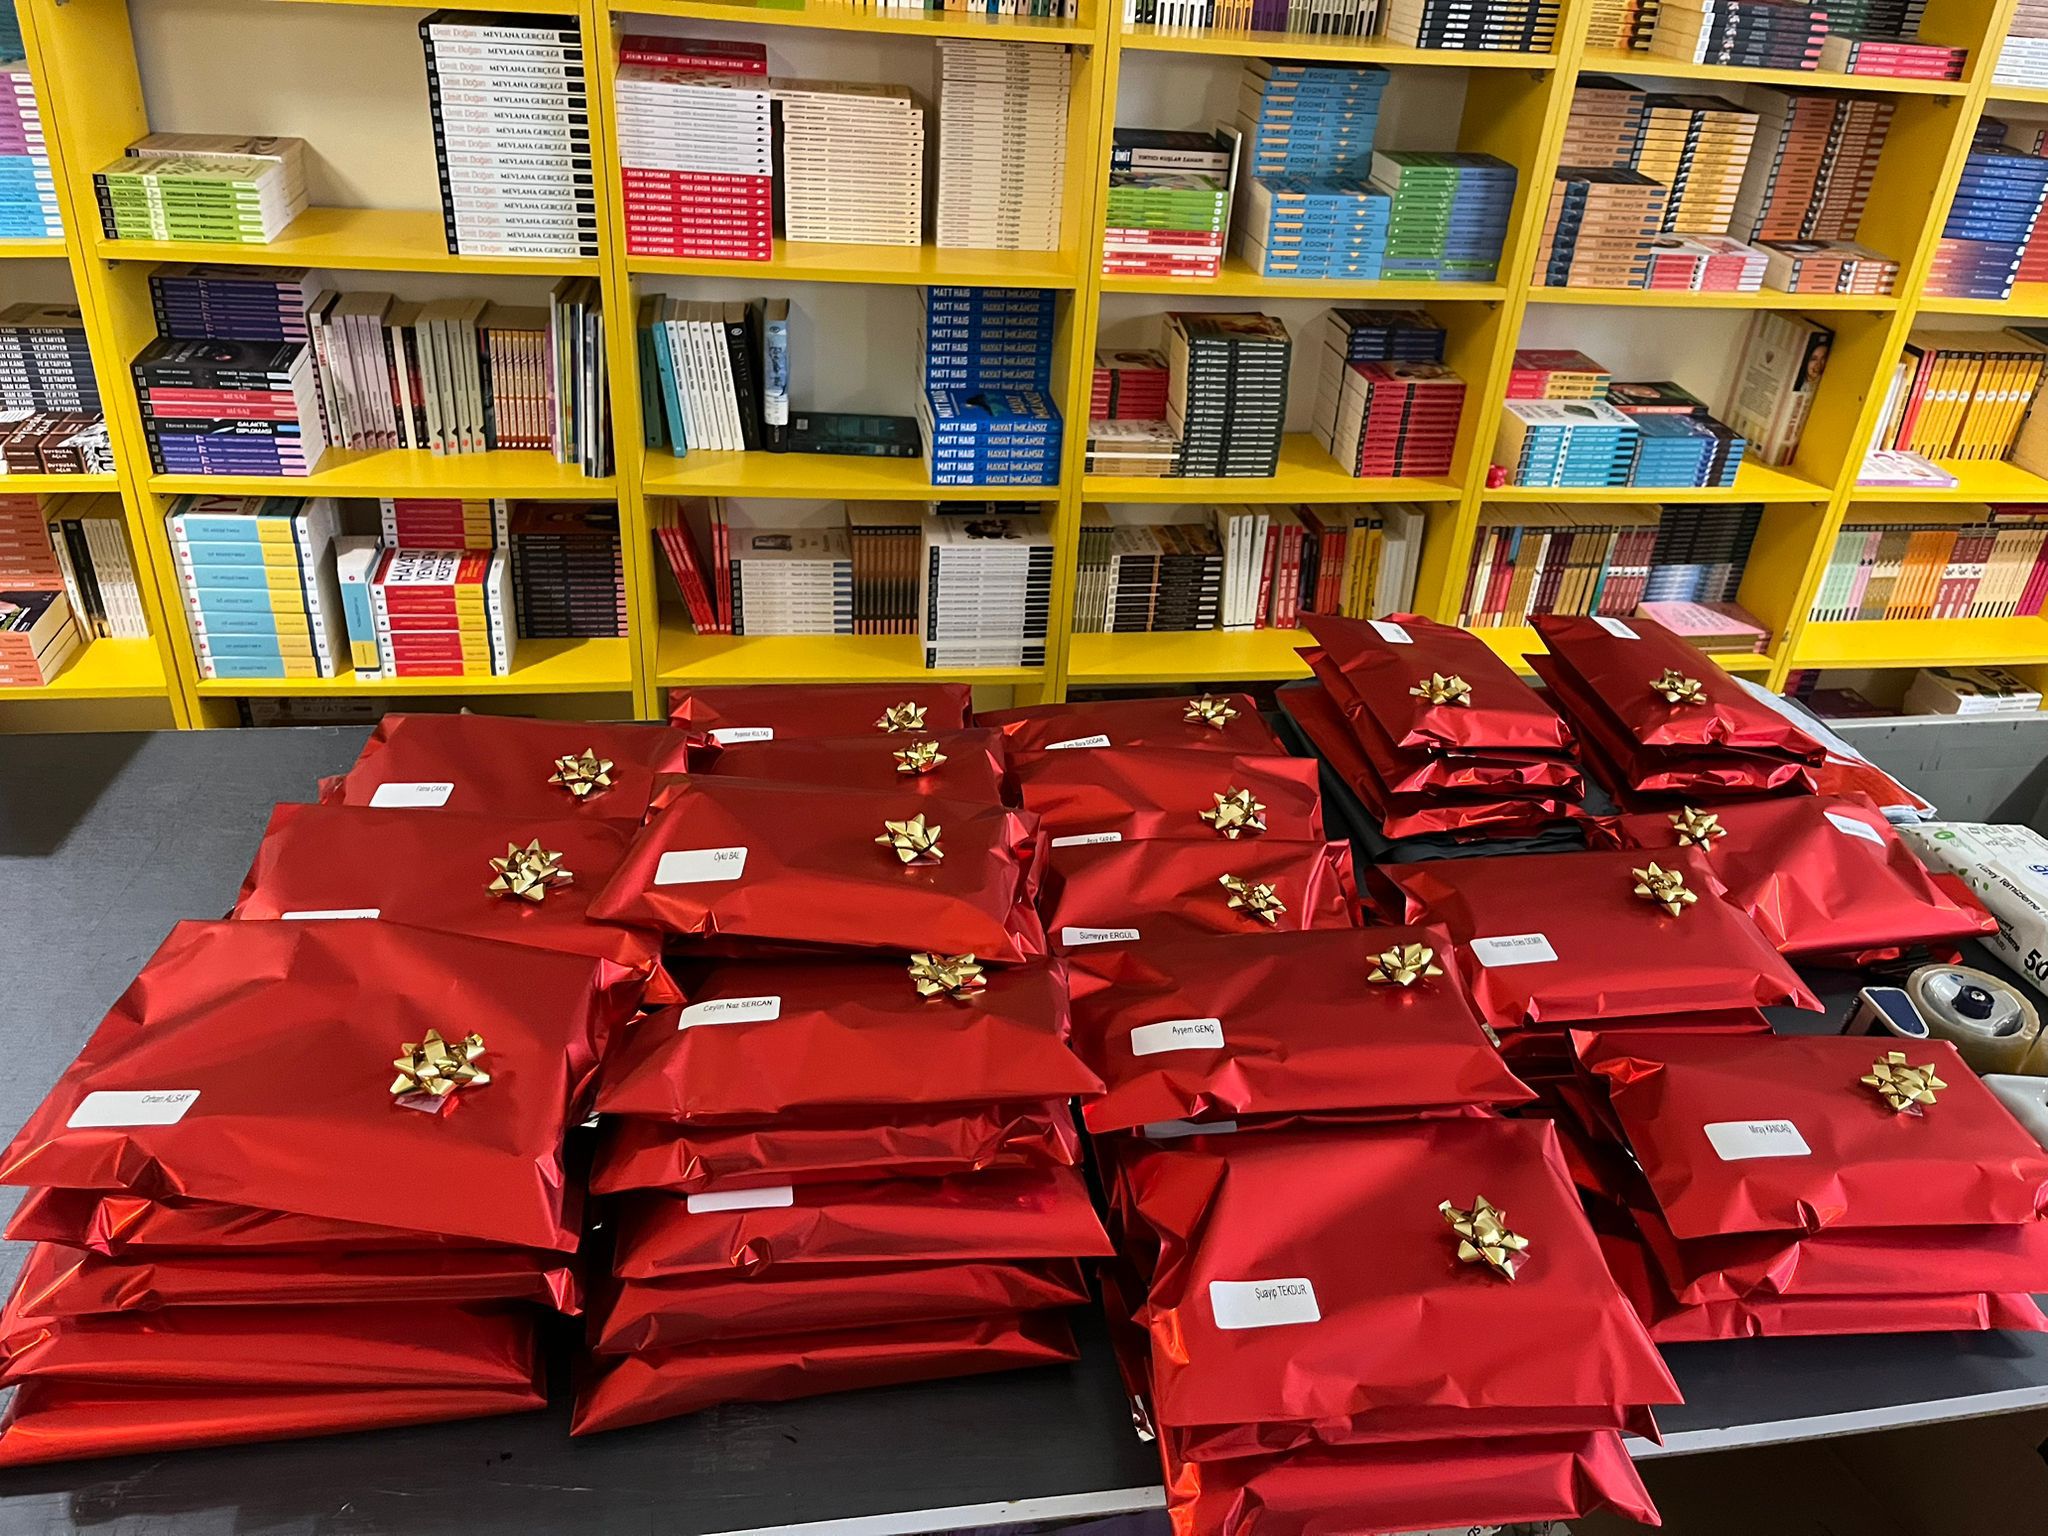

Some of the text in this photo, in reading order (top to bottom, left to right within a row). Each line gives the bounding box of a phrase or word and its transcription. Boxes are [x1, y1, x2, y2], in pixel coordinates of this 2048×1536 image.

[958, 436, 975, 444] HAIG
[729, 851, 739, 860] BAL
[2024, 948, 2048, 980] 50
[1172, 1024, 1214, 1035] Ayşem GENÇ
[1278, 1284, 1307, 1296] TEKDUR
